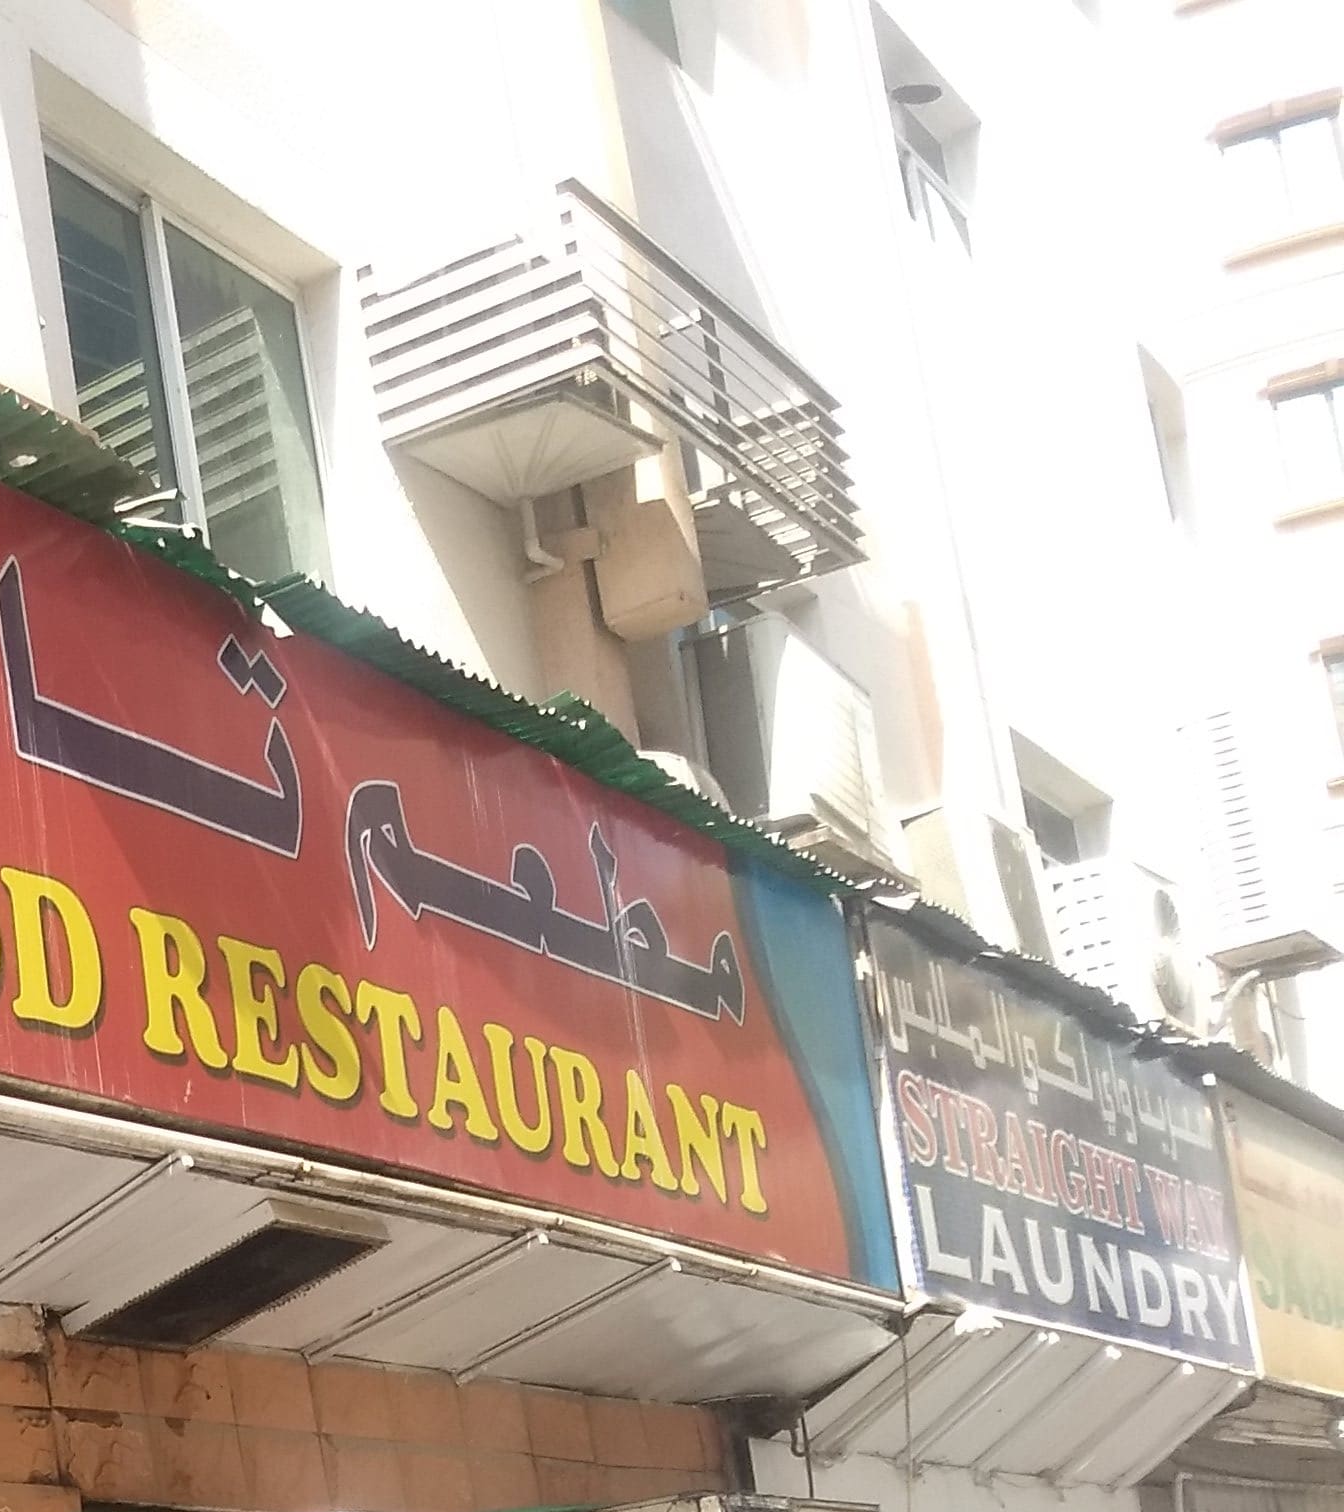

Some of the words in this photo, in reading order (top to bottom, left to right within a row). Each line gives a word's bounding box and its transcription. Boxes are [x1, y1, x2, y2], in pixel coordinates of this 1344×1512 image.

[345, 780, 745, 1027] مطعم
[129, 906, 768, 1214] RESTAURANT
[897, 1069, 1145, 1236] STRAIGHT
[1143, 1164, 1230, 1262] WAY
[914, 1184, 1240, 1345] LAUNDRY
